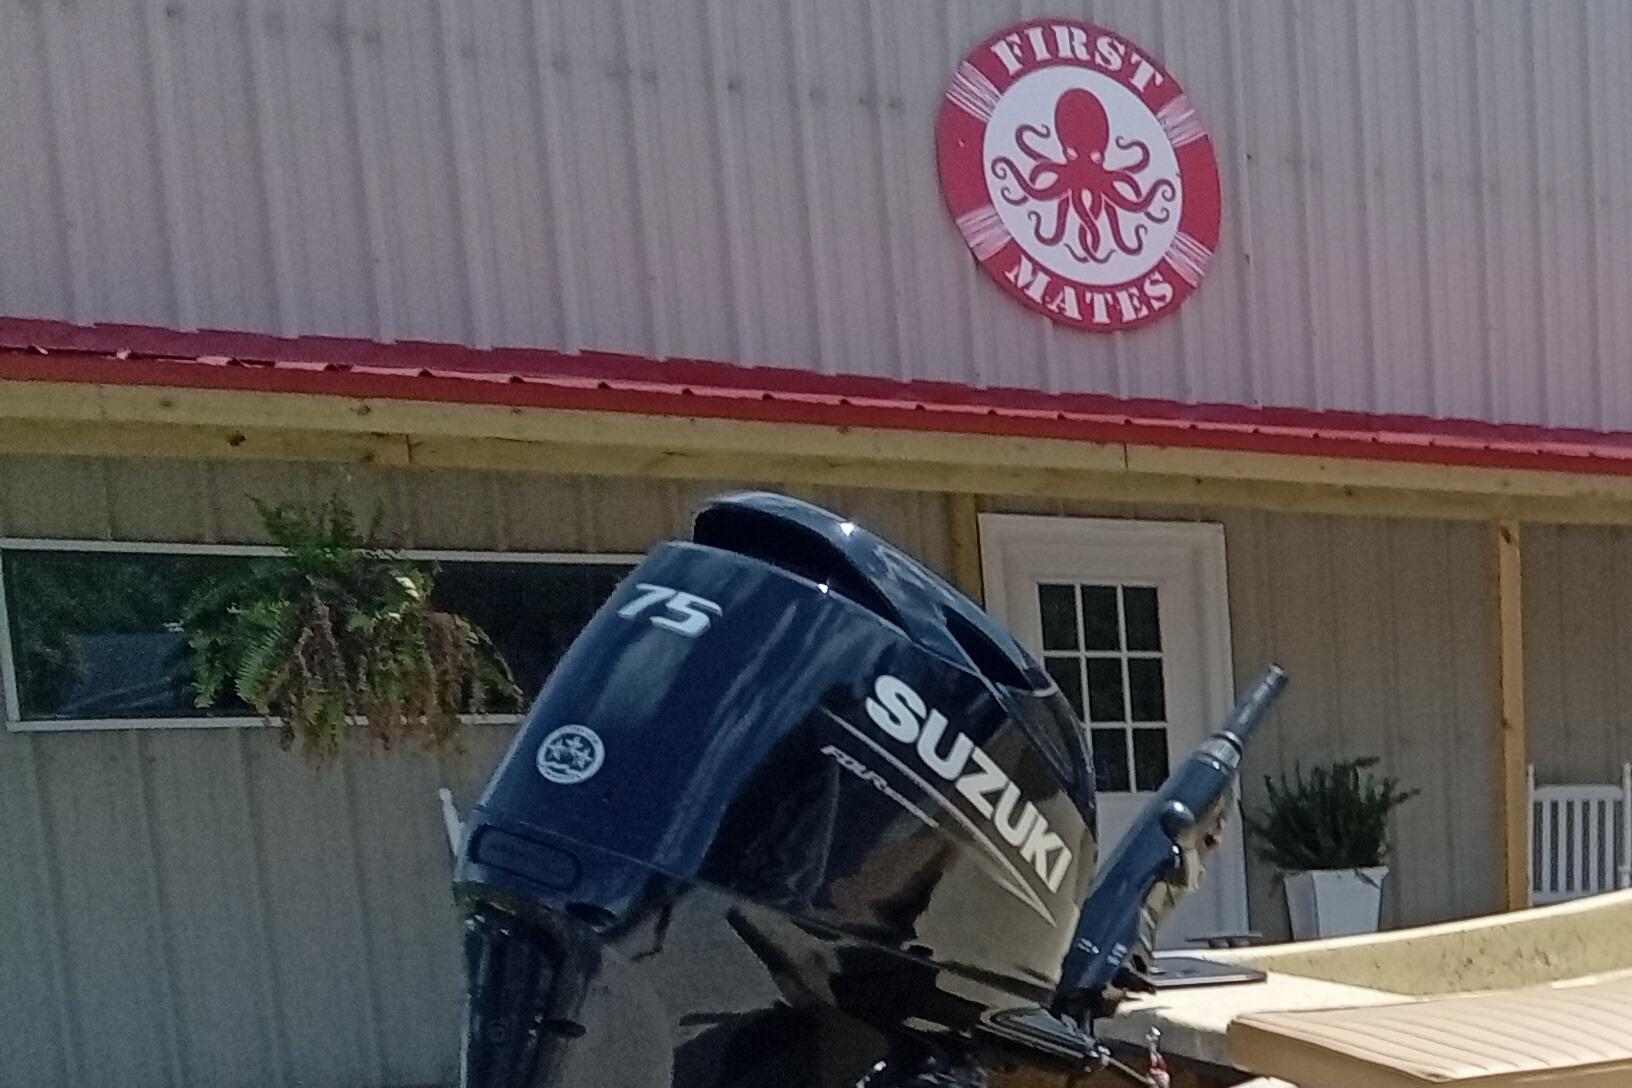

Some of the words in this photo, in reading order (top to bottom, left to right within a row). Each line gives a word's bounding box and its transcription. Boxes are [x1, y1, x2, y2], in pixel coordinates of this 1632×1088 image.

[991, 25, 1164, 94] FIRST
[1005, 254, 1174, 324] MATES
[618, 583, 723, 639] 75
[865, 674, 1073, 894] SUZUKI
